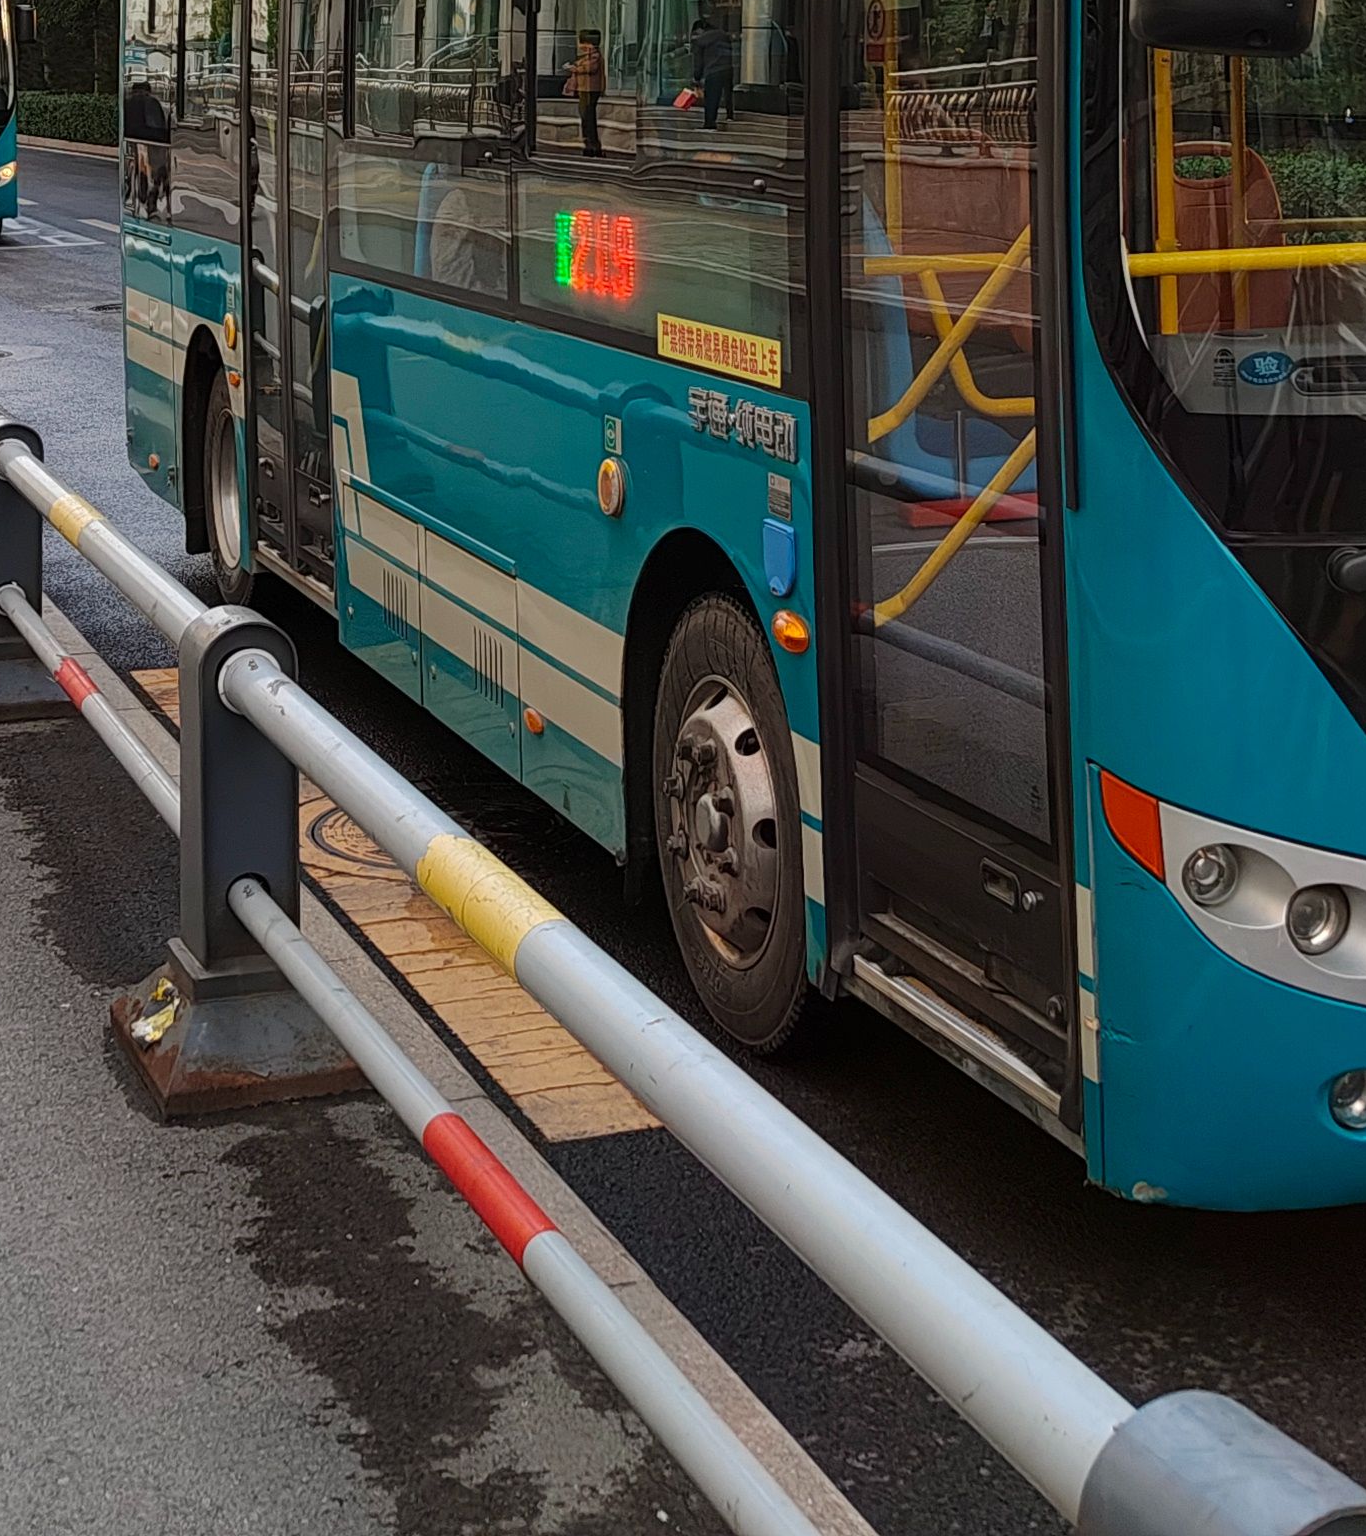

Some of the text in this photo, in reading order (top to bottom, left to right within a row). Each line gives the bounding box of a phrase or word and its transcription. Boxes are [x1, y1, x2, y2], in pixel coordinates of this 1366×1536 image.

[660, 320, 778, 379] 严禁携带易燃易爆危险品上车
